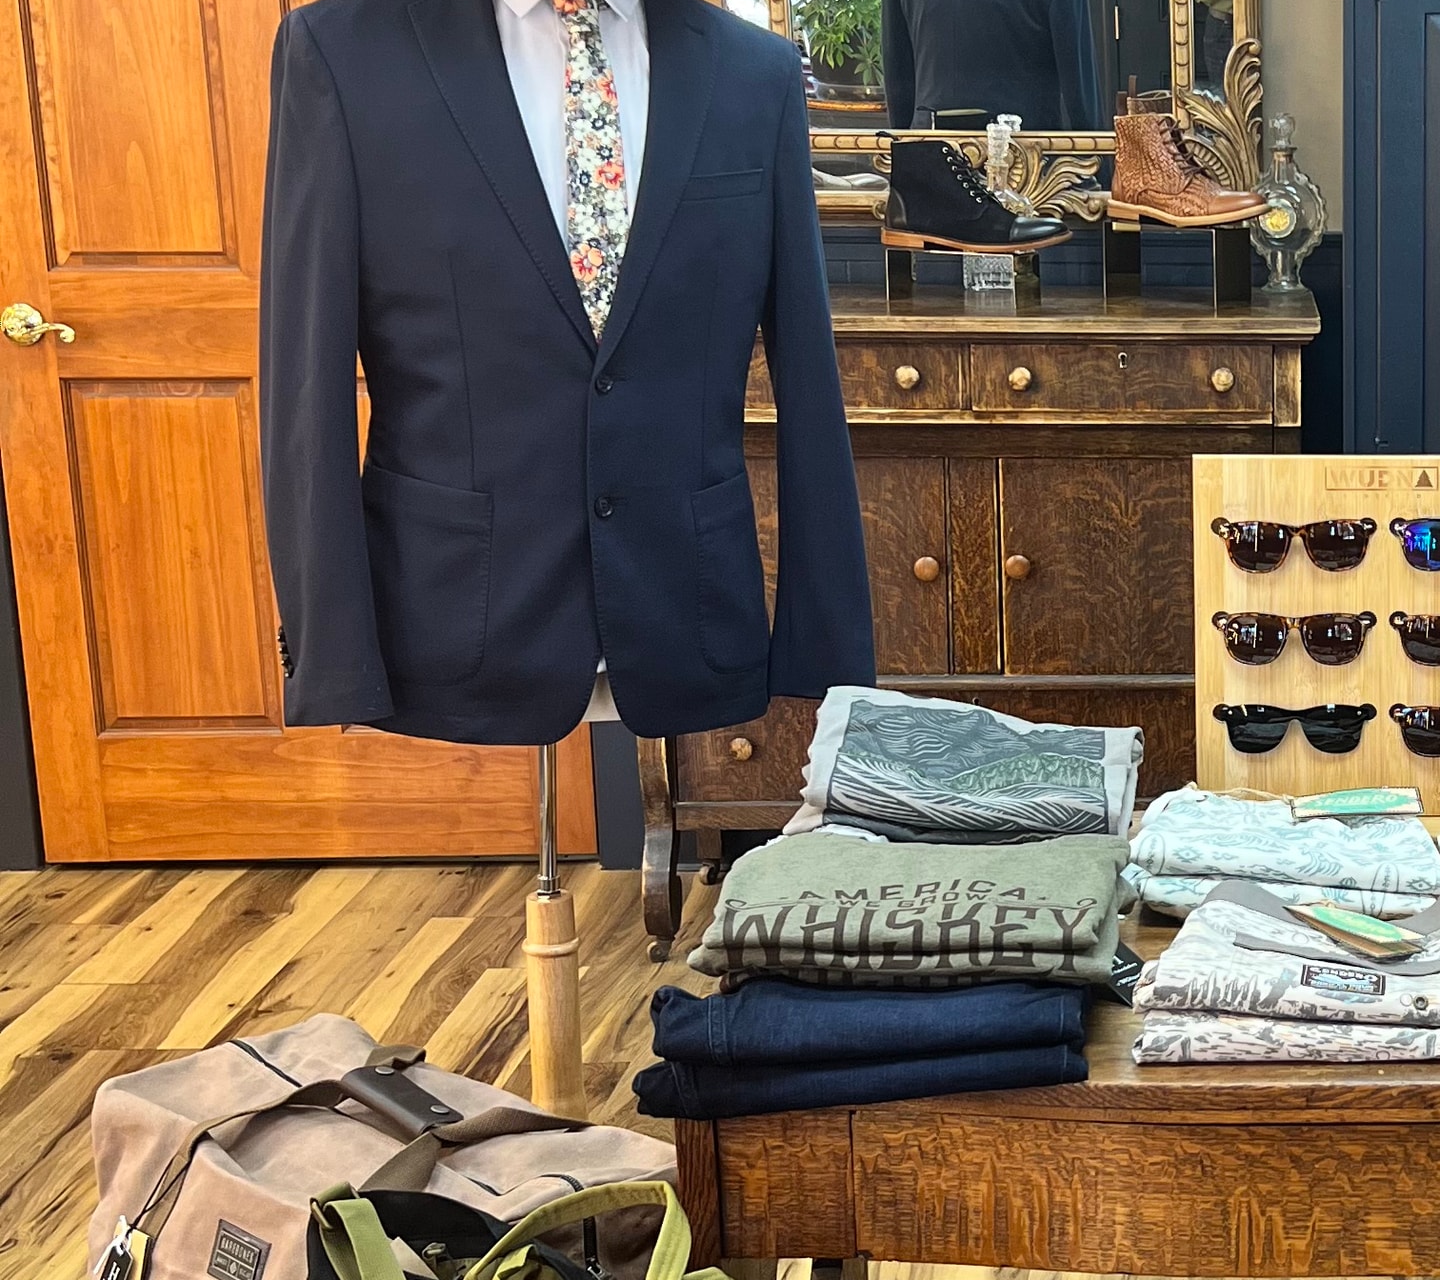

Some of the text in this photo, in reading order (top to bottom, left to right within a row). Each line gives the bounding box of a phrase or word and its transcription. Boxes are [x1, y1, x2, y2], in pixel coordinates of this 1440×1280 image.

[798, 879, 1027, 901] AMERICA
[839, 891, 986, 908] WE GROW
[722, 901, 1096, 970] WHISKEY
[221, 1237, 254, 1264] BAREBONES
